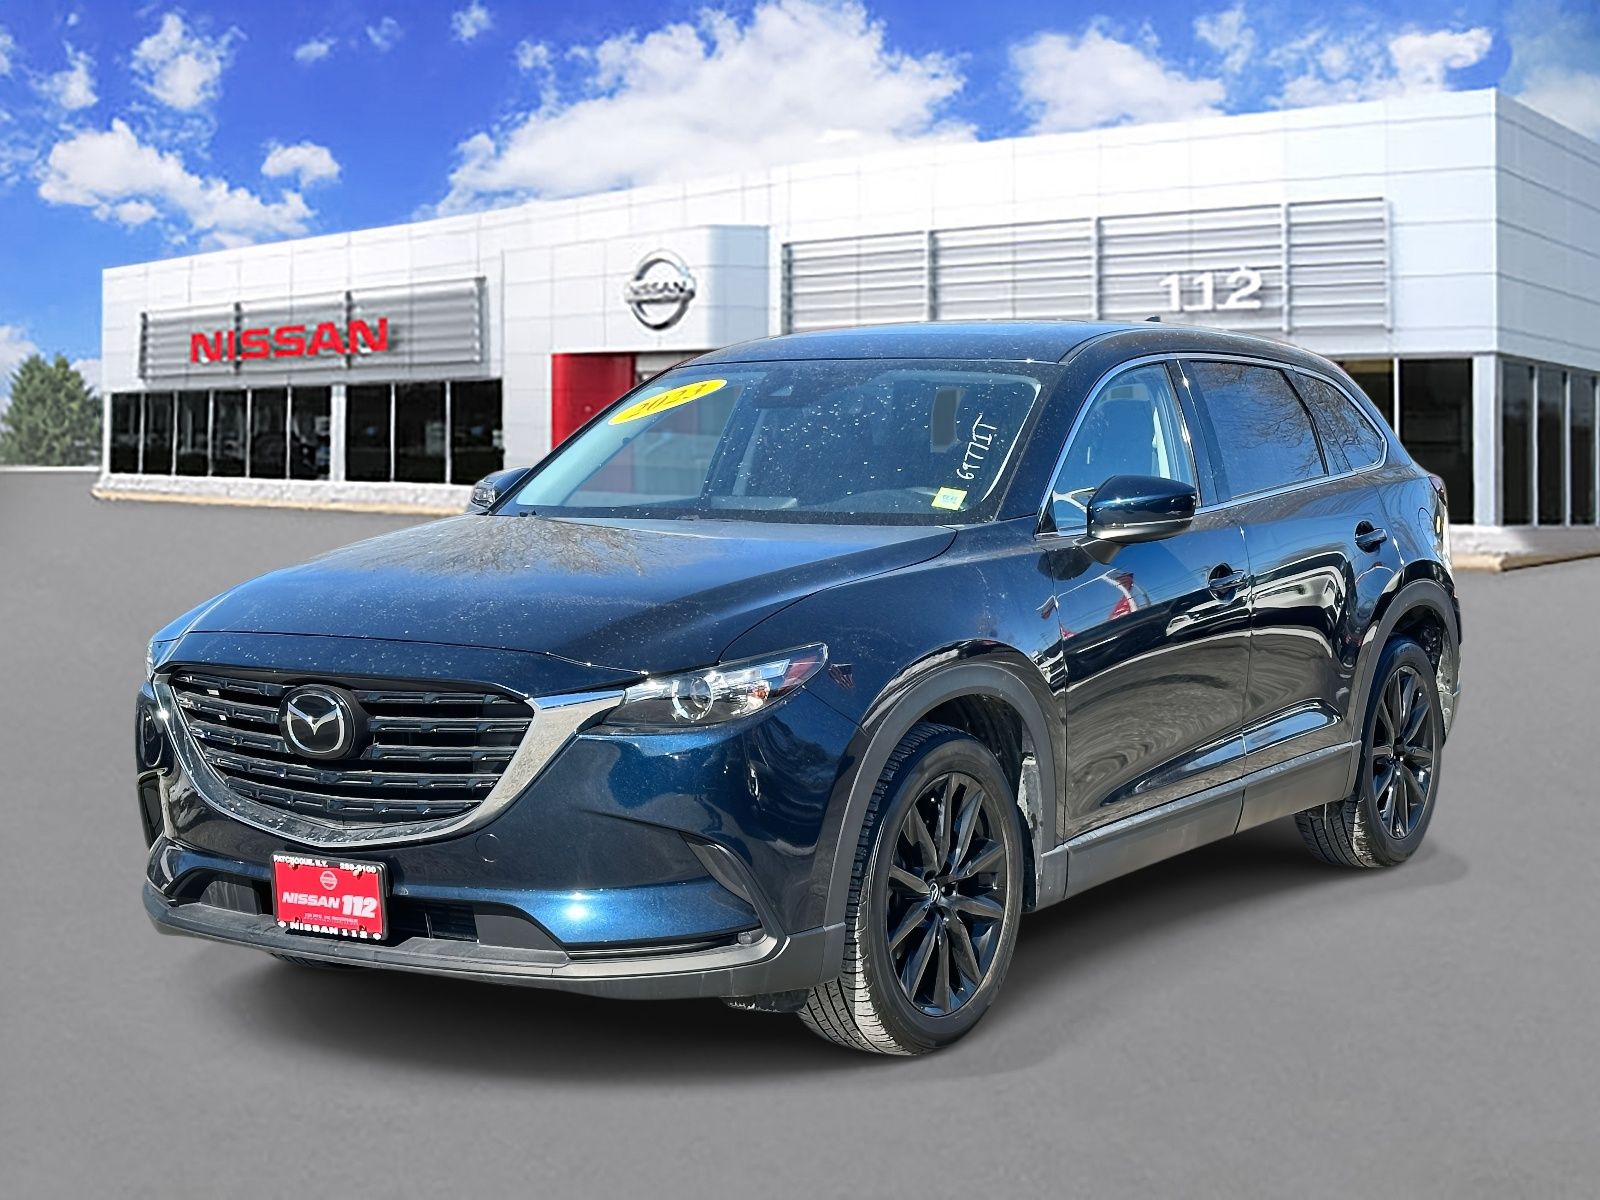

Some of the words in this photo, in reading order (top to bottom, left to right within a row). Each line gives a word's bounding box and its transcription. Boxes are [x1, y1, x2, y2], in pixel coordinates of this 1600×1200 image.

[1159, 268, 1262, 312] 112
[190, 317, 388, 363] NISSAN
[628, 383, 708, 419] 2023
[282, 891, 340, 909] NISSAN
[342, 894, 378, 918] 112
[290, 921, 339, 935] NISSAN
